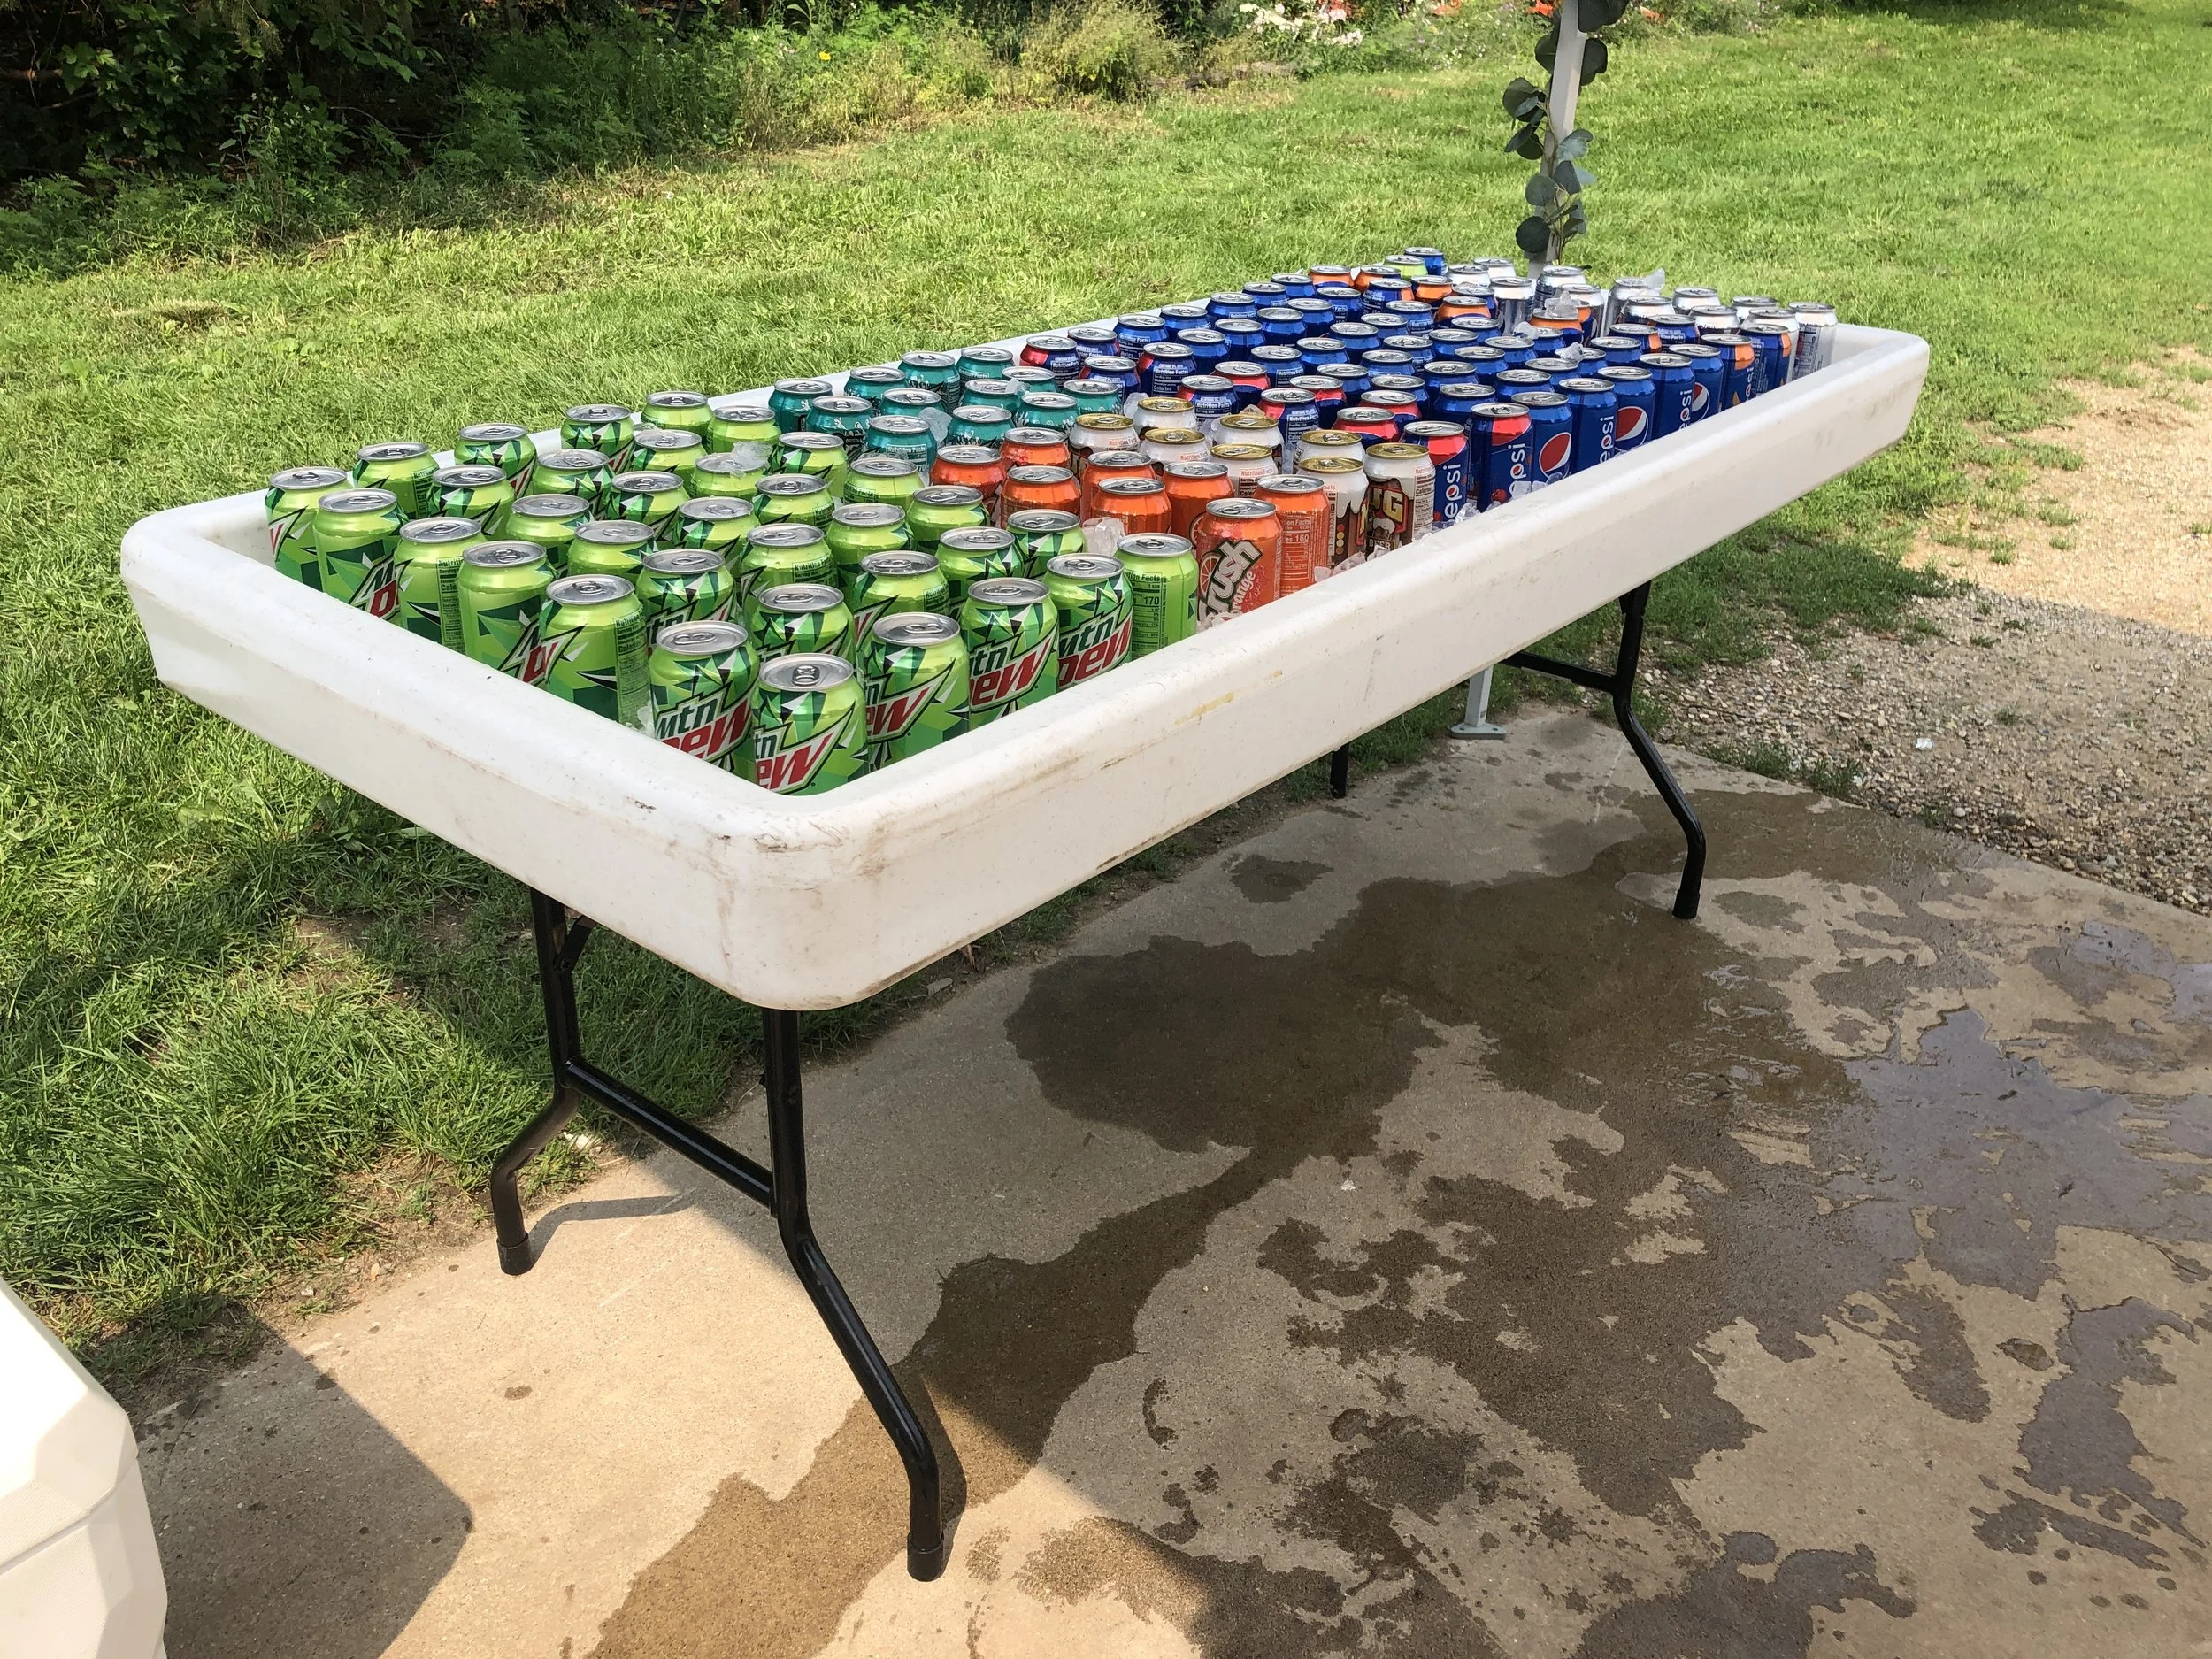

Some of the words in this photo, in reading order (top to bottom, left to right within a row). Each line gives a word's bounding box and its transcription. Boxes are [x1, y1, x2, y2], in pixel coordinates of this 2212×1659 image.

[1679, 390, 1692, 430] epsi
[1599, 415, 1614, 463] epsi
[1444, 464, 1462, 518] epsi
[1144, 596, 1159, 605] 170
[970, 646, 1008, 677] tn
[756, 733, 778, 759] tn
